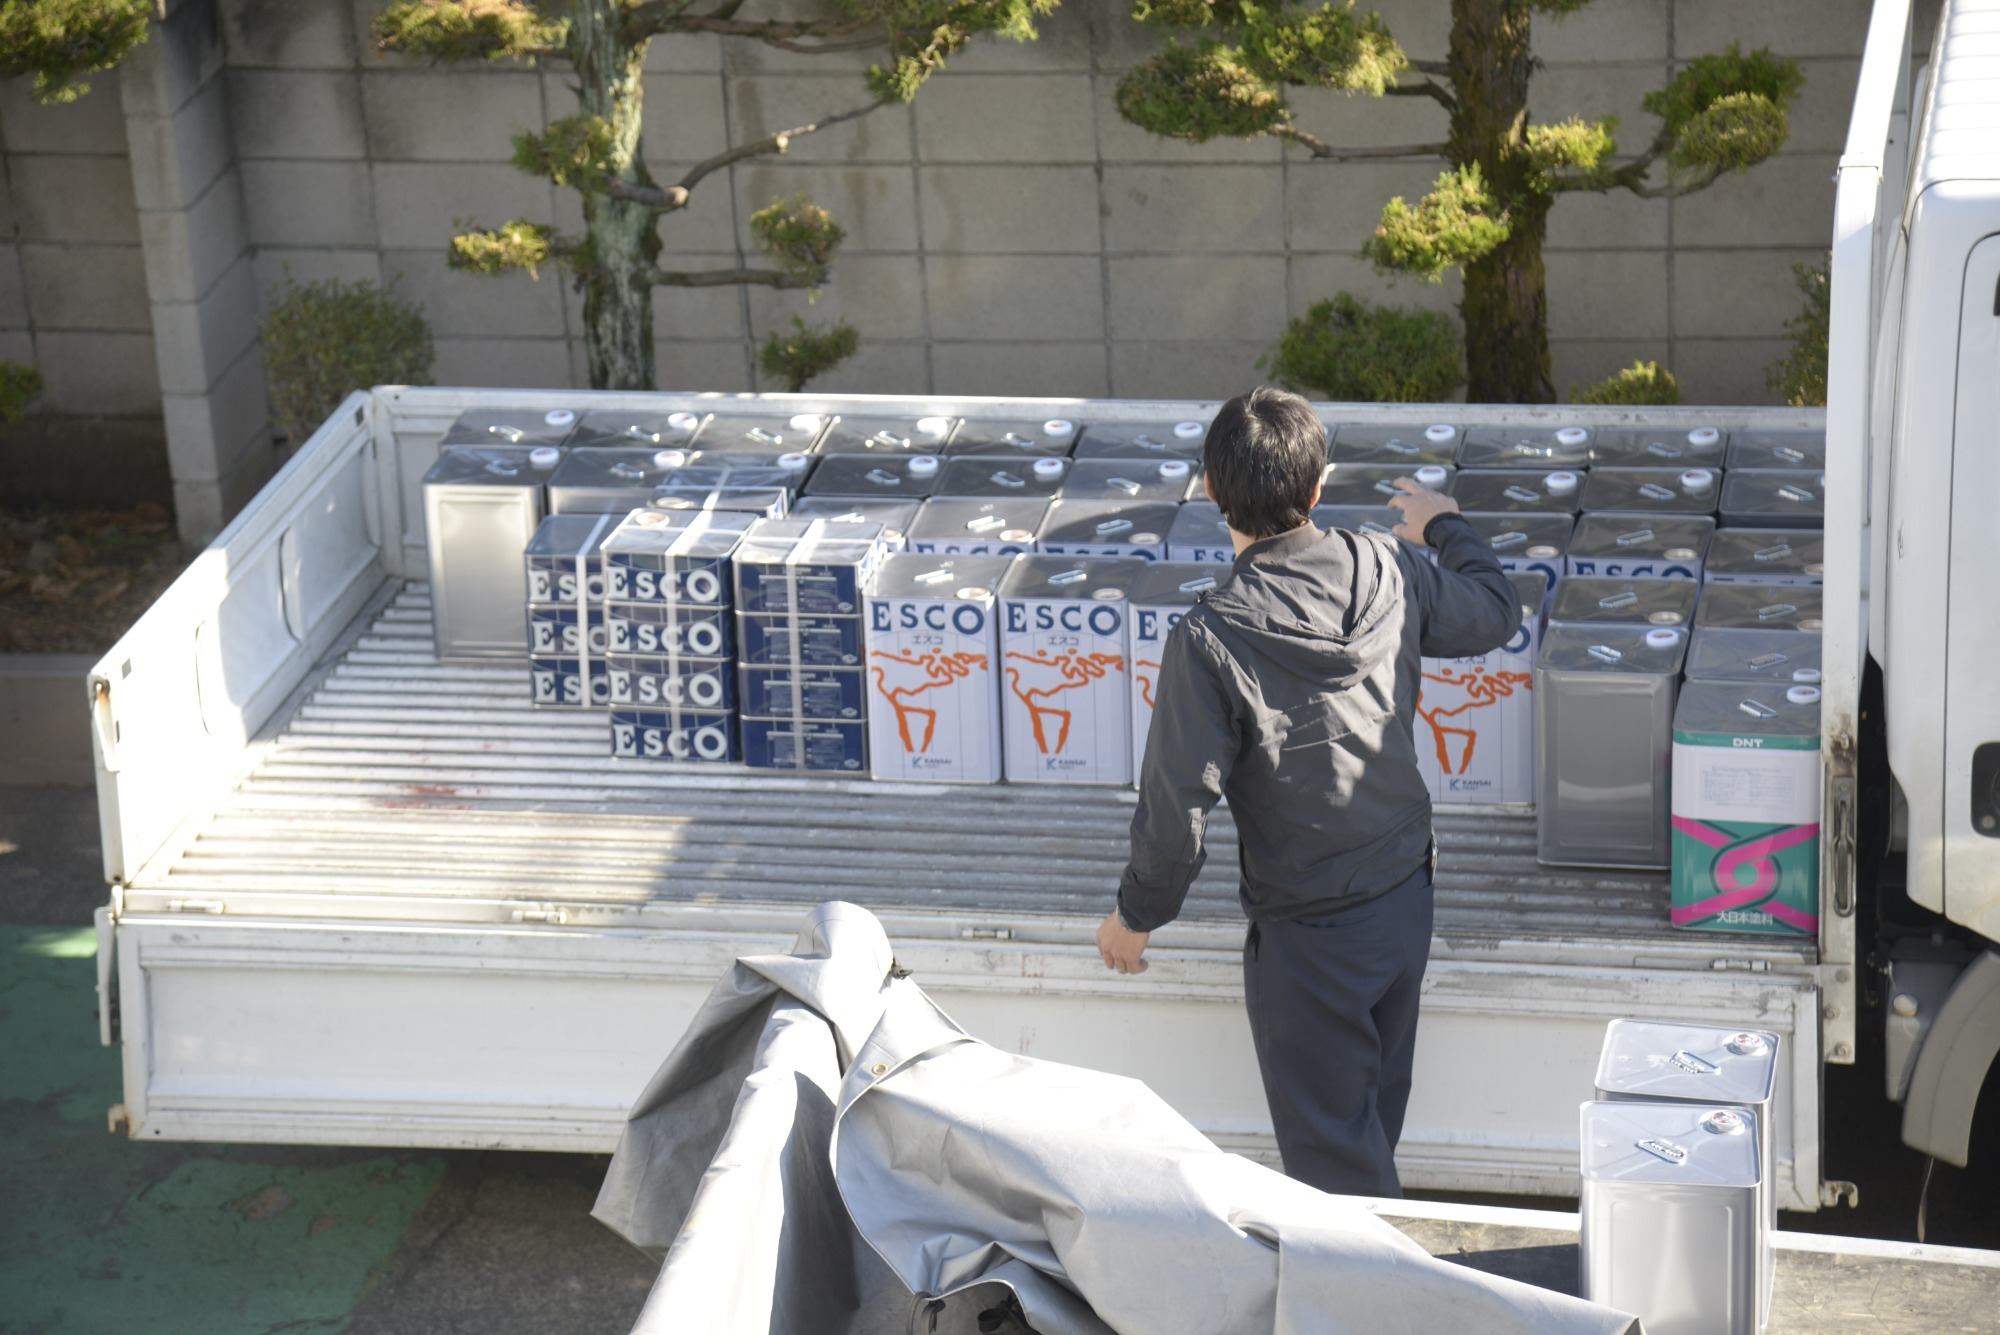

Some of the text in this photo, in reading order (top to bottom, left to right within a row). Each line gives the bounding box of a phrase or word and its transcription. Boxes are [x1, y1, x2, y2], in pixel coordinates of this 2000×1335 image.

[528, 570, 605, 602] ESC
[606, 566, 720, 602] ESCO
[872, 601, 985, 635] ESCO
[1006, 602, 1121, 636] ESCO
[532, 621, 607, 654] ESC
[607, 619, 722, 655] ESCO
[912, 635, 945, 645] エスコ
[1048, 636, 1079, 646] エスコ
[533, 671, 609, 704] ESC
[609, 671, 723, 706] ESCO
[612, 724, 728, 760] ESCO
[1732, 738, 1764, 748] DNT
[1716, 911, 1774, 925] 大日本塗料
